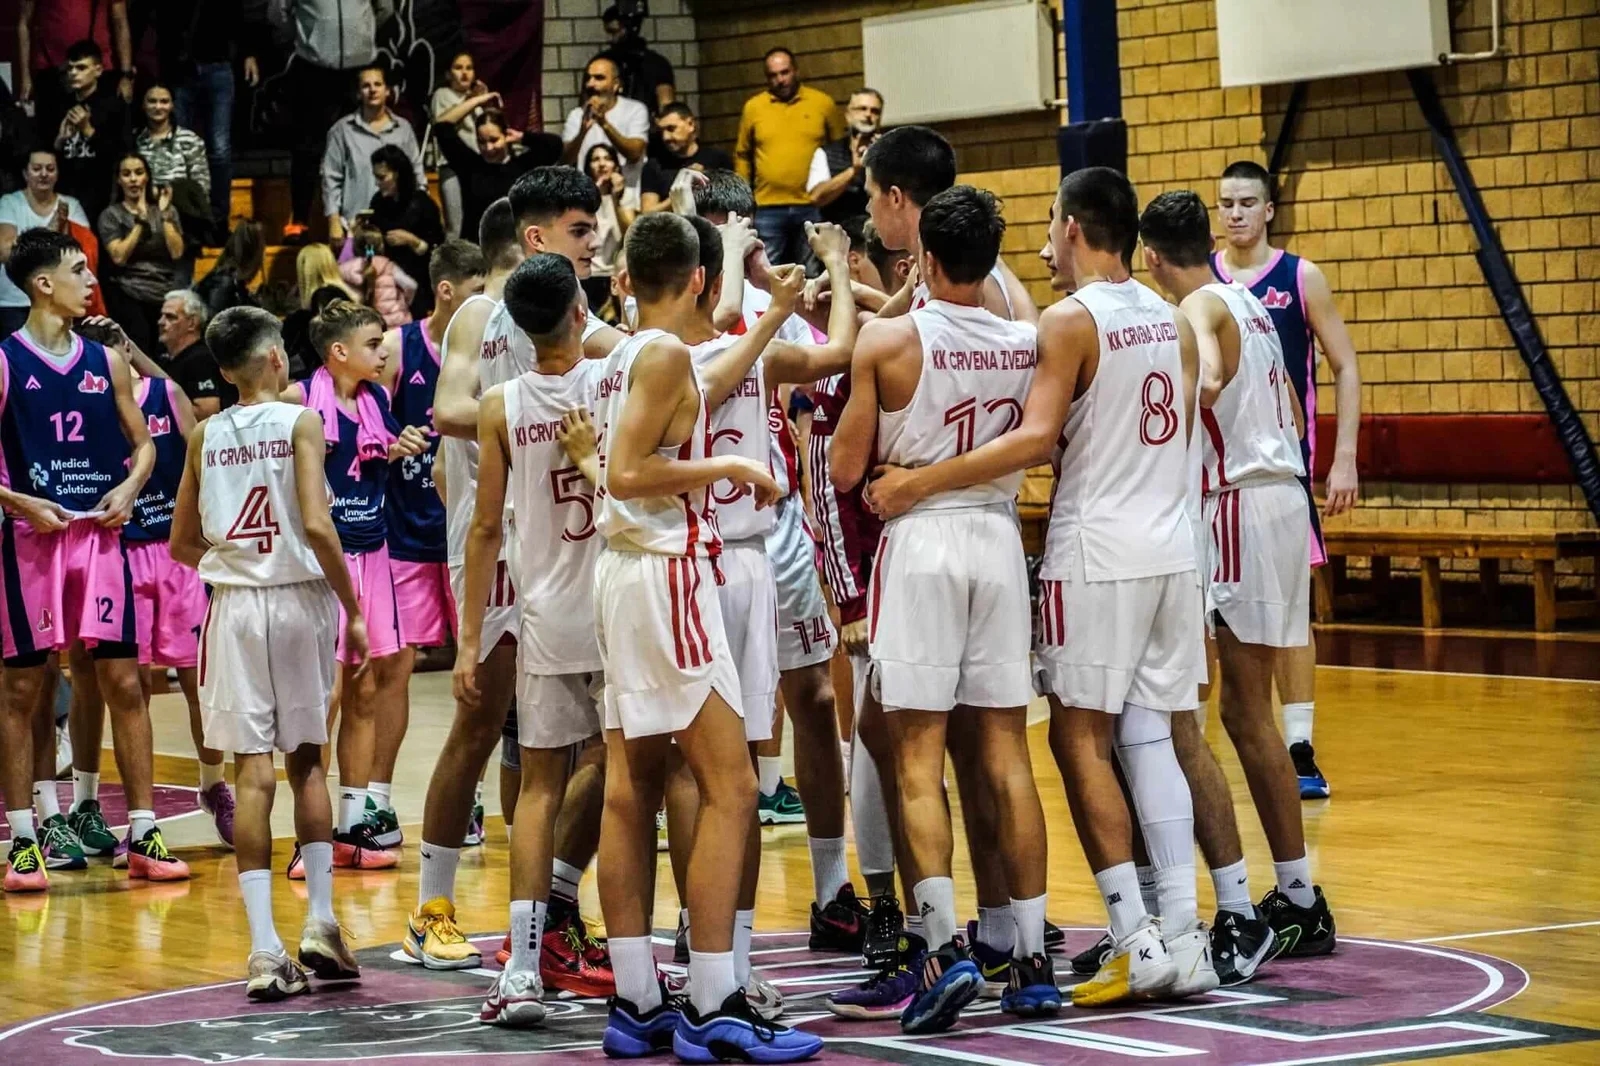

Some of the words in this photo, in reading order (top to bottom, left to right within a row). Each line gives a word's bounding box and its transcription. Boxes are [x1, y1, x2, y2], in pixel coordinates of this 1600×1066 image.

[1107, 330, 1123, 351] KK
[1152, 322, 1178, 342] ZVEZ
[932, 350, 947, 370] KK
[949, 351, 998, 371] CRVENA
[1000, 350, 1037, 370] ZVEZDA
[1140, 370, 1179, 447] 8
[49, 410, 85, 442] 12
[943, 396, 1024, 456] 12
[51, 457, 90, 471] Medical
[346, 455, 362, 482] 4
[55, 485, 98, 496] Solutions
[335, 496, 369, 507] Medical
[550, 464, 597, 543] 5
[226, 486, 281, 554] 4
[95, 597, 114, 624] 12
[792, 615, 831, 655] 14
